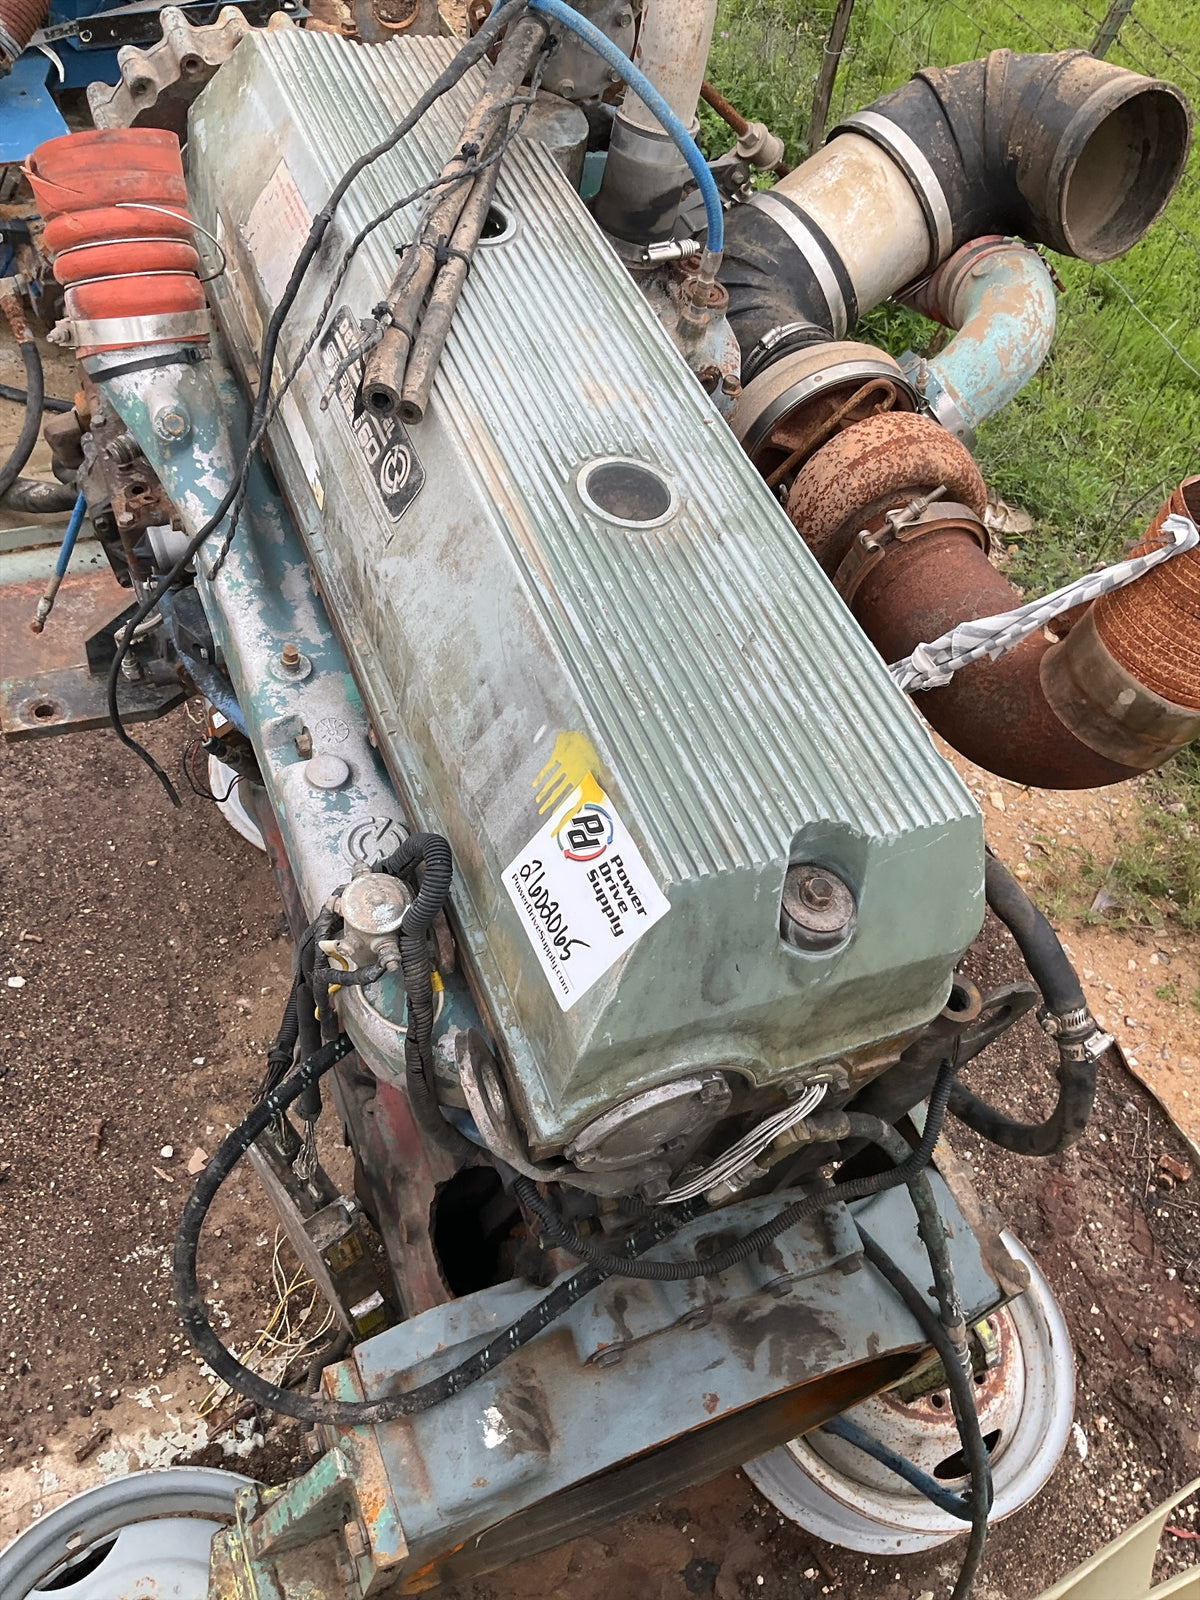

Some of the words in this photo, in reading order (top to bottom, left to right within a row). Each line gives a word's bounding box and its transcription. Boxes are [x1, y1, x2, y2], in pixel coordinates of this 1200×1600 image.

[358, 422, 381, 465] 60
[586, 869, 625, 938] Supply
[598, 862, 629, 914] Drive
[610, 854, 648, 917] Power
[511, 873, 570, 995] PowerDriveSupply.com
